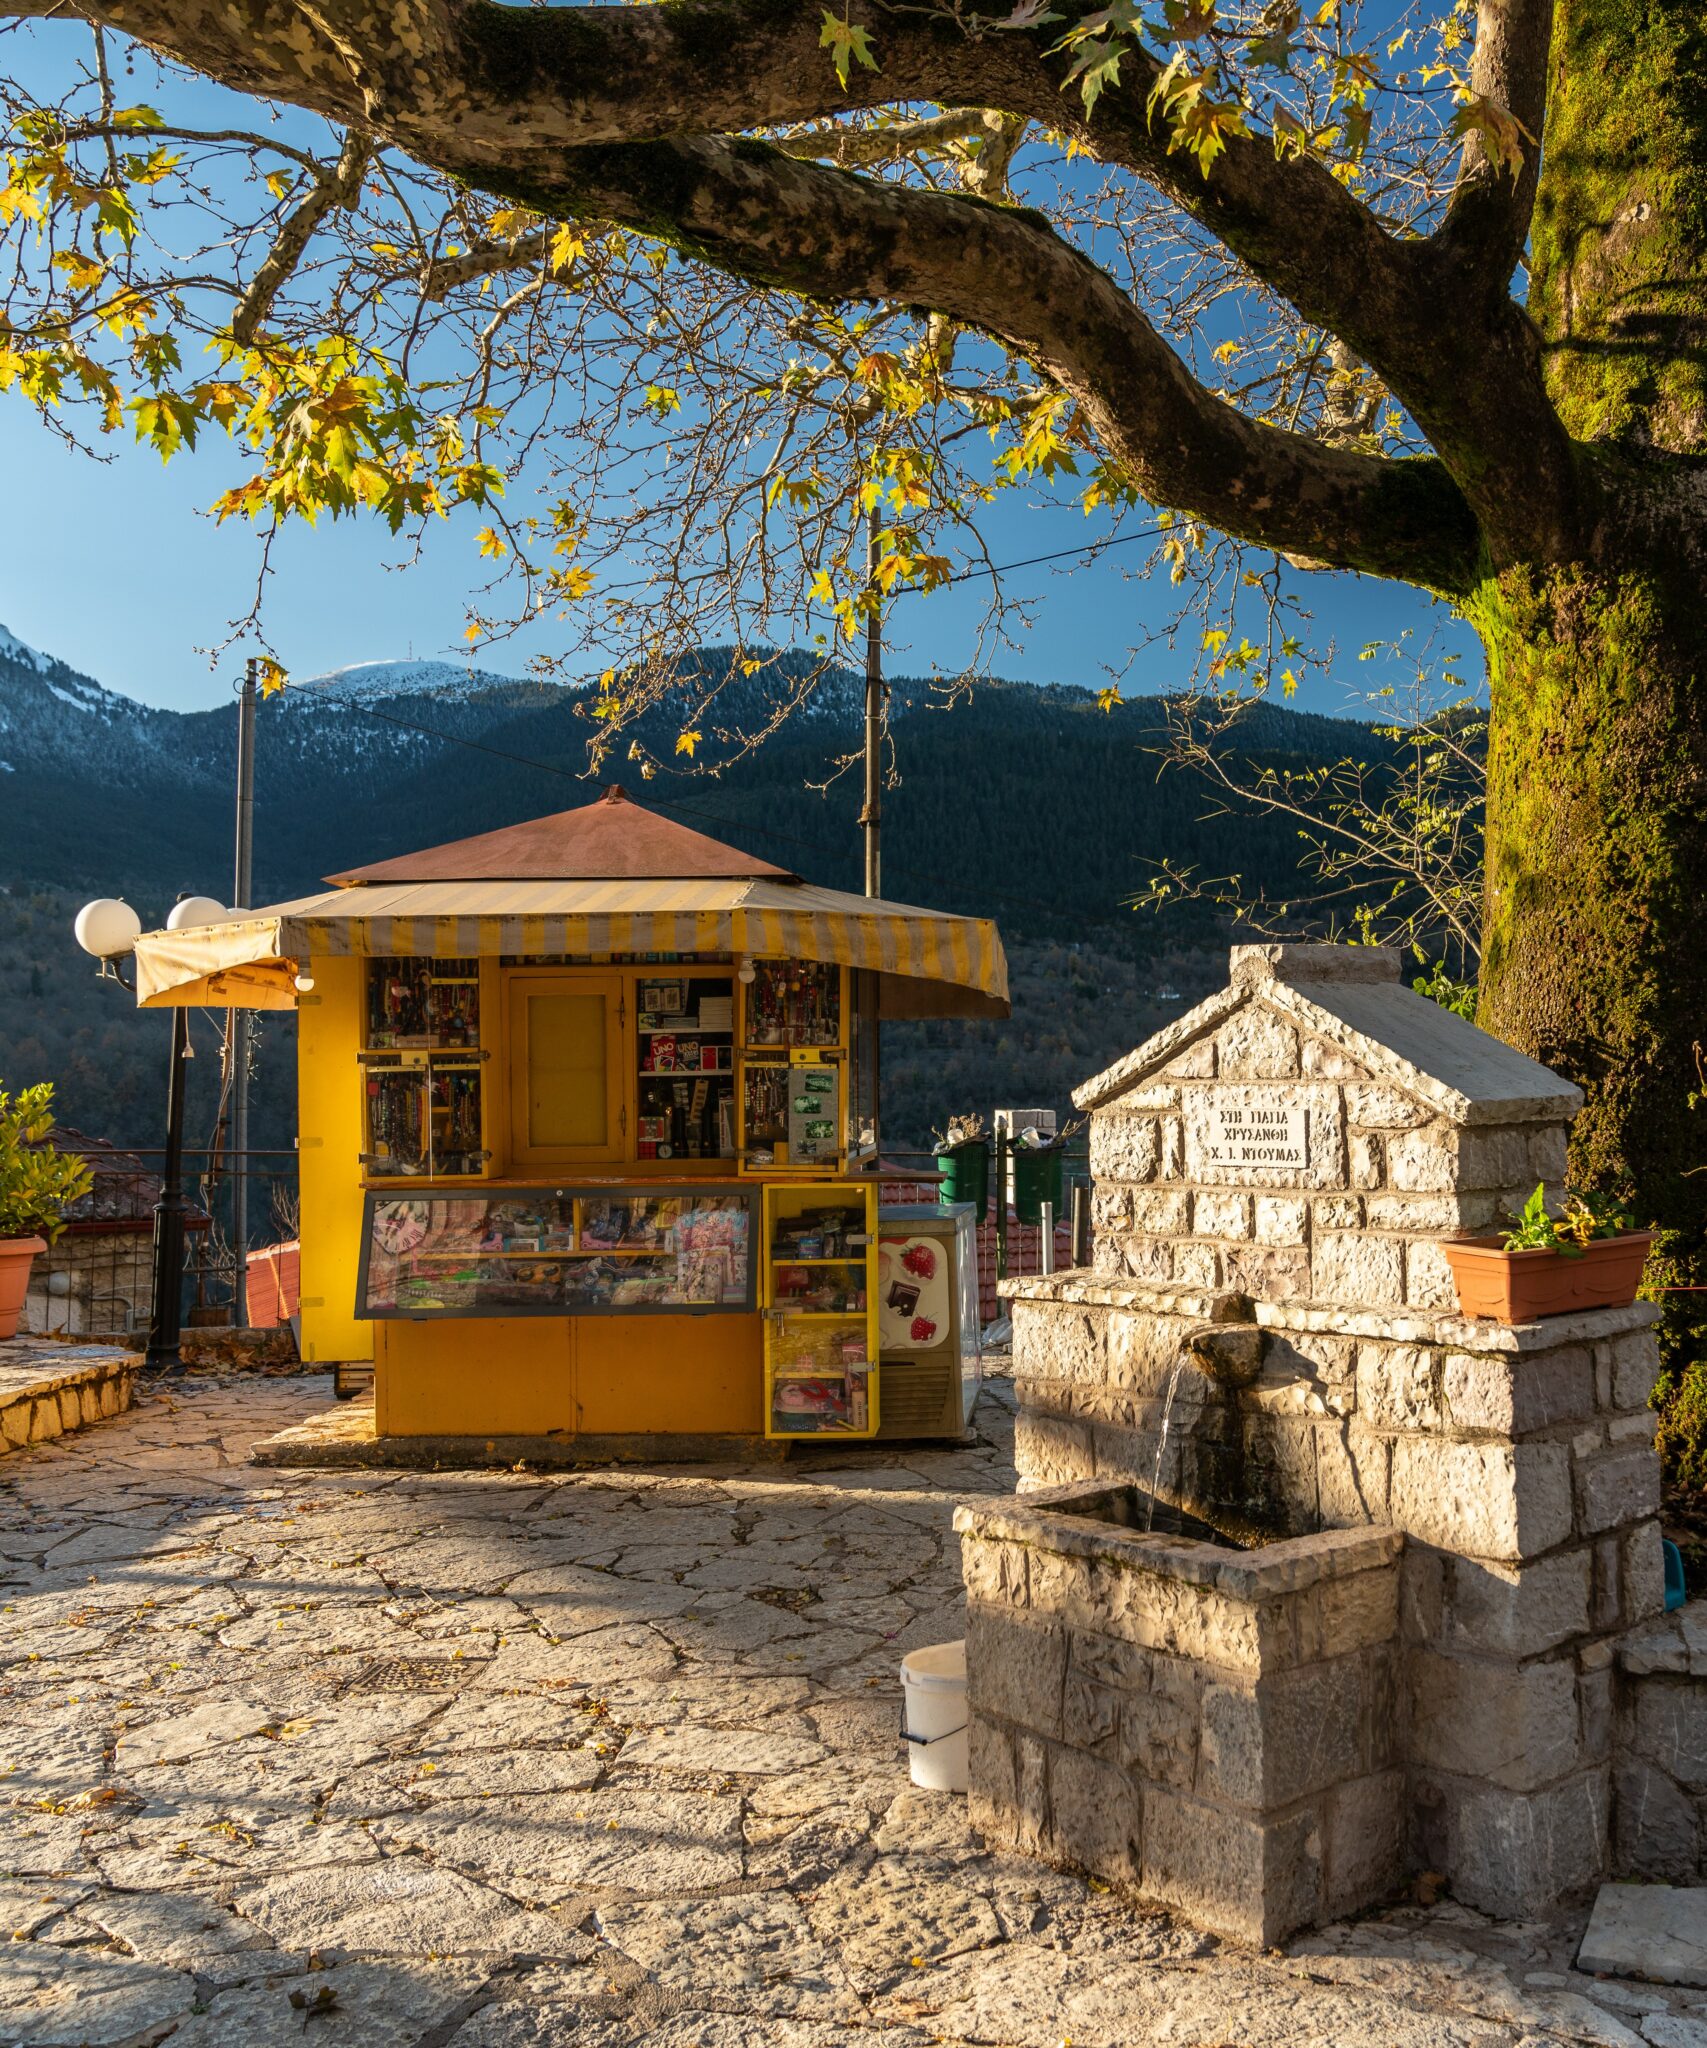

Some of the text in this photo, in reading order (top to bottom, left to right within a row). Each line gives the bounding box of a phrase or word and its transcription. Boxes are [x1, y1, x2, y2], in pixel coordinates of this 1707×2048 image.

[653, 1042, 674, 1055] UNO
[677, 1041, 698, 1053] UNO
[1220, 1110, 1242, 1123] ΣΤΗ
[1224, 1128, 1288, 1141] ΧΡΥΣΑΝΘΗ
[1242, 1147, 1302, 1161] ΝΤΟΥΜΑΣ
